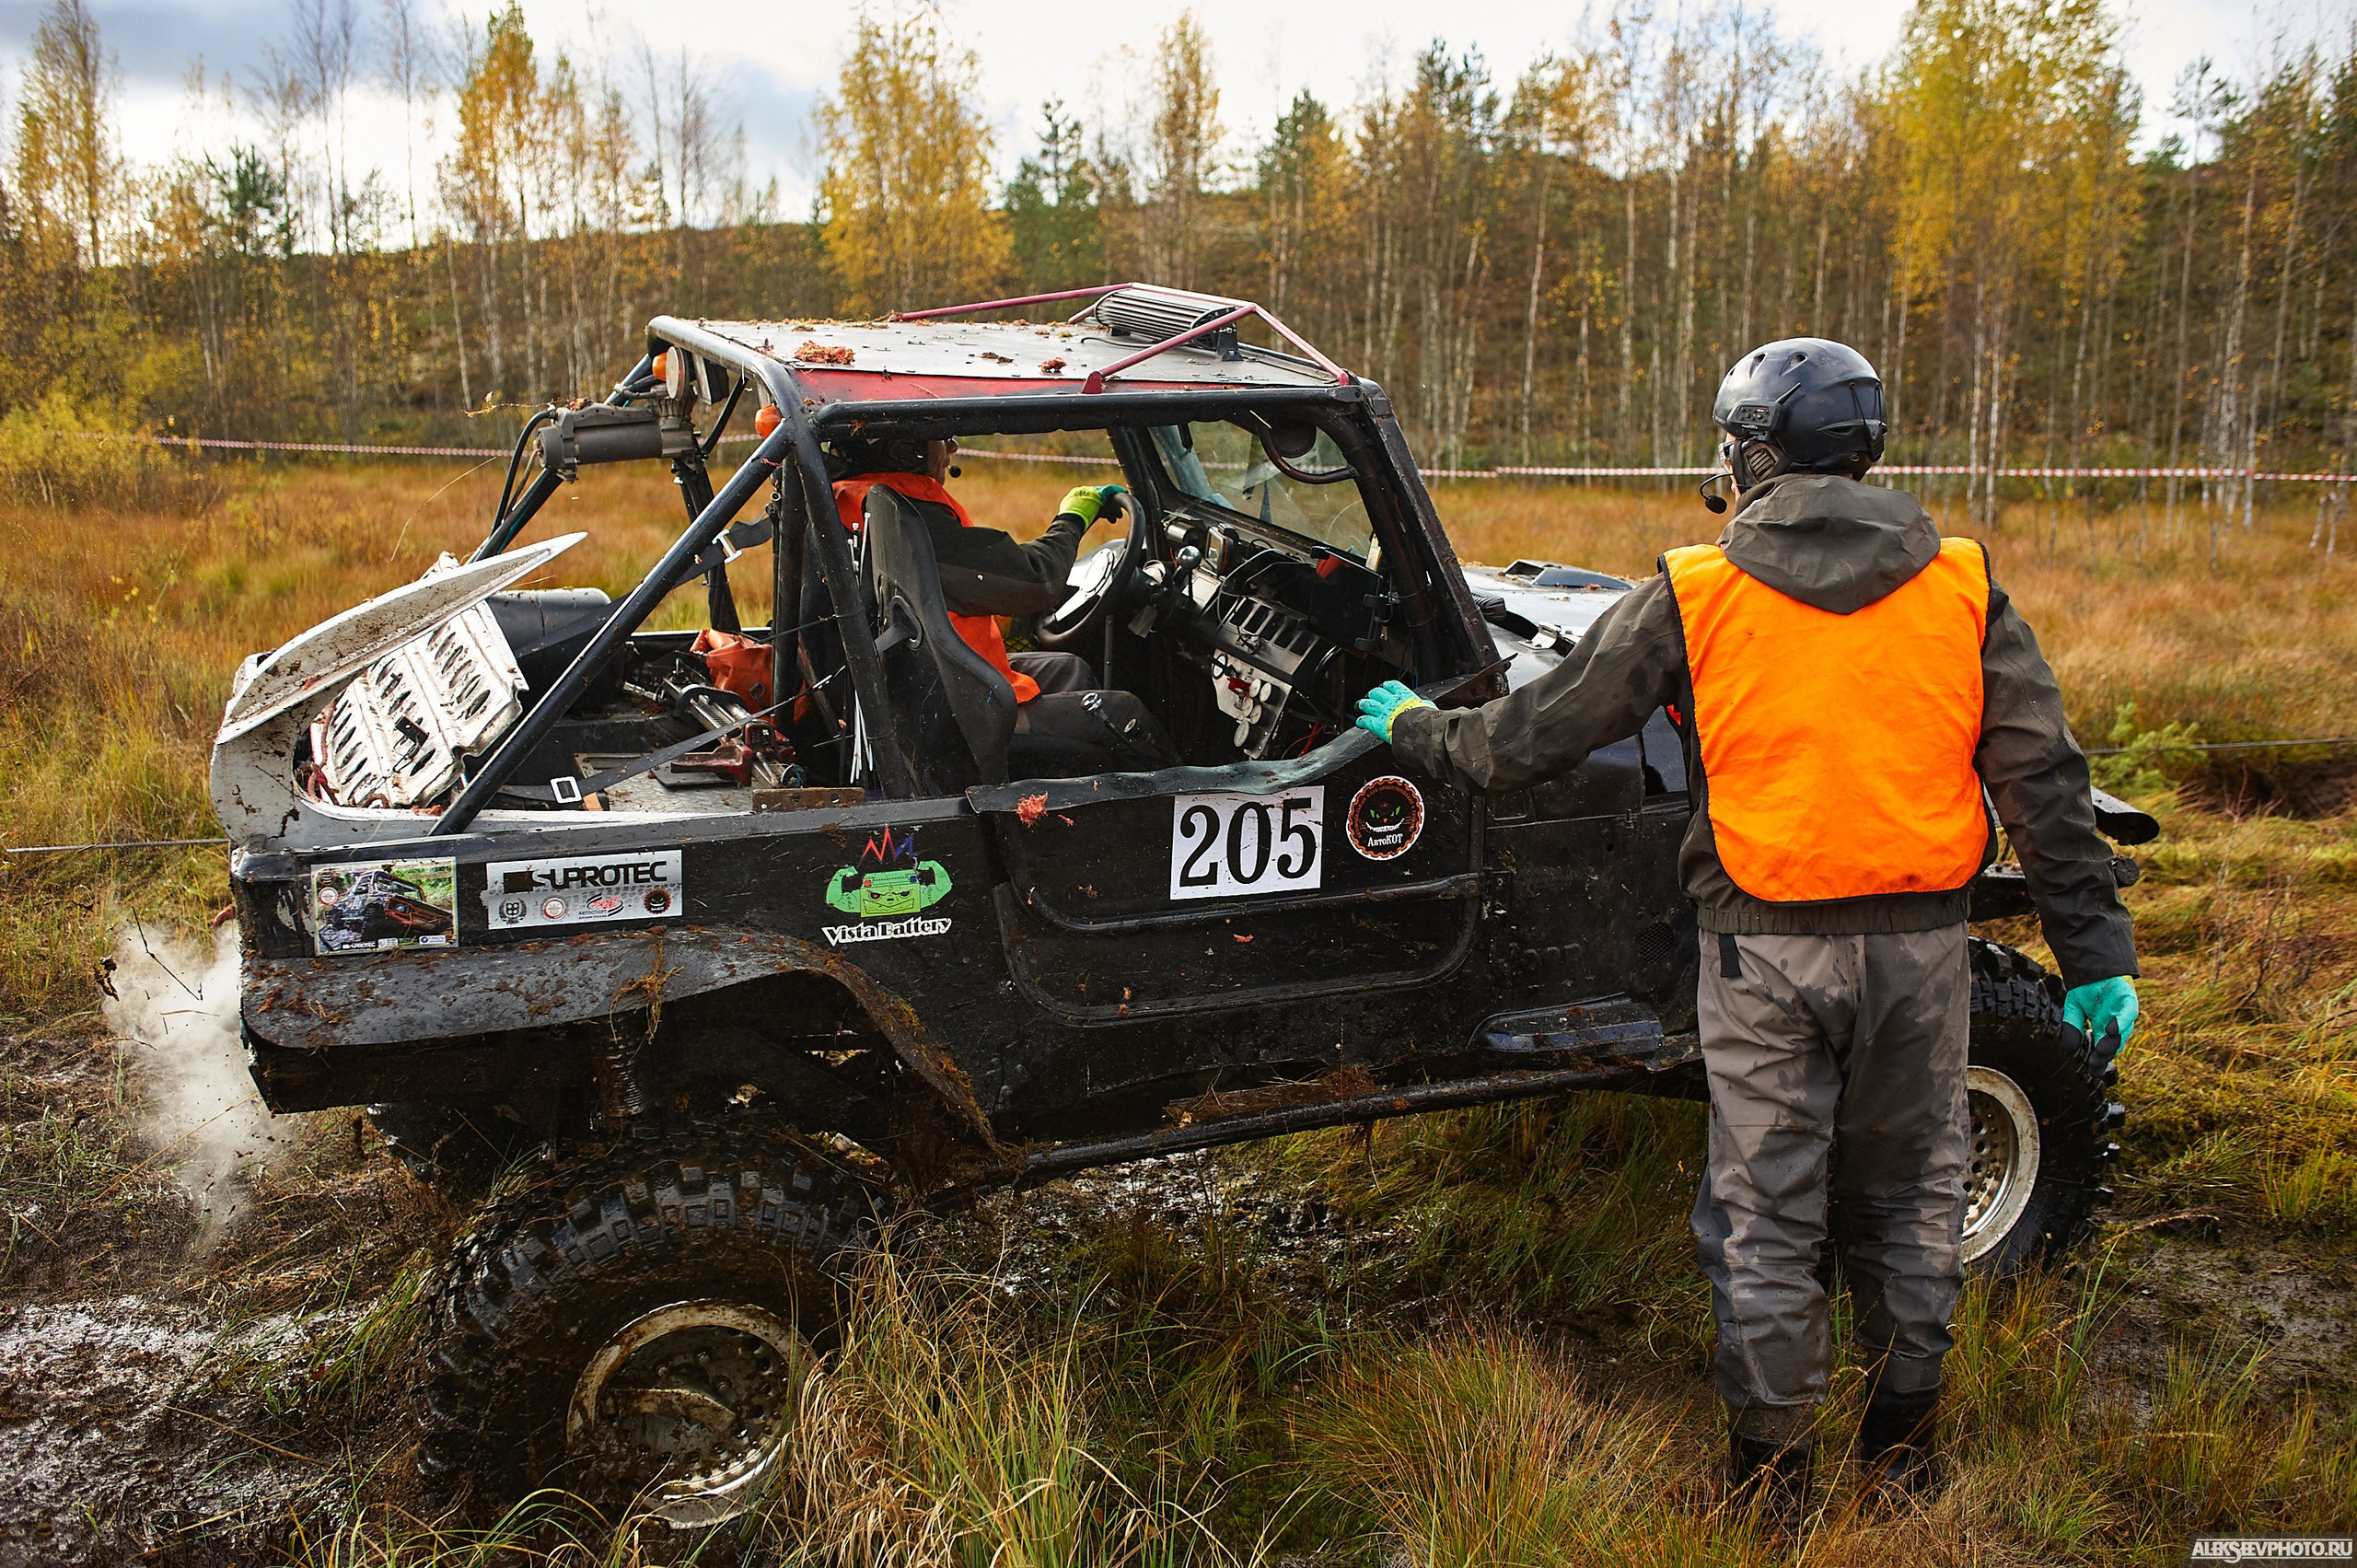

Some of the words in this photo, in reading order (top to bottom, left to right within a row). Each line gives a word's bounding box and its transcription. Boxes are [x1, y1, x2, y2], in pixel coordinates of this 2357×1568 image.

[1179, 797, 1317, 887] 205
[525, 860, 668, 890] SUPROTEC
[822, 923, 877, 947] Vista
[877, 917, 952, 938] Battery
